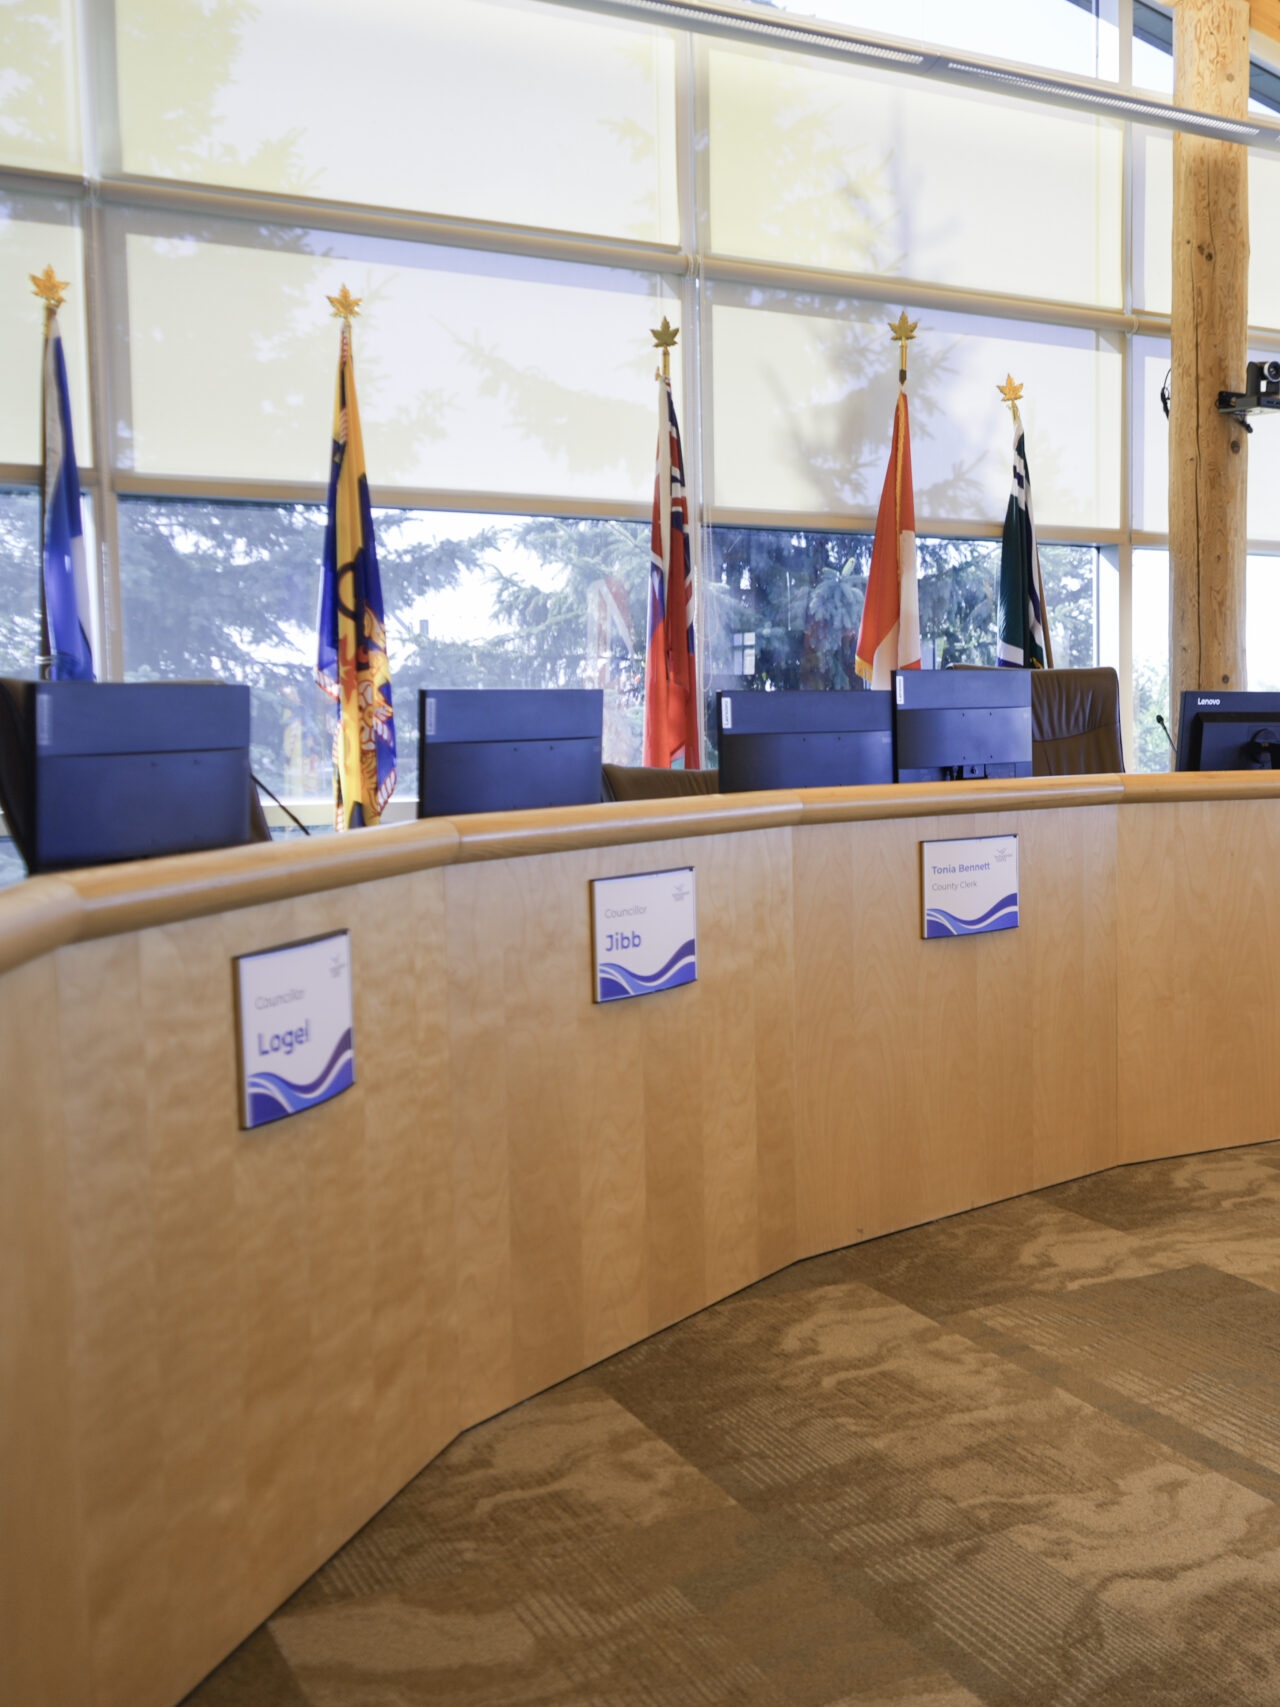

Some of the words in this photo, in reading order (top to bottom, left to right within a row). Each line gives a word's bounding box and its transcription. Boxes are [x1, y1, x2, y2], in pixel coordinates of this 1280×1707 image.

[1197, 697, 1220, 706] Lenovo
[931, 863, 956, 875] Tonia
[958, 862, 990, 873] Bennett
[931, 881, 958, 892] County
[959, 879, 977, 890] Clerk
[604, 904, 647, 920] Councillor
[605, 930, 642, 952] Jibb
[257, 1017, 311, 1057] Logel
